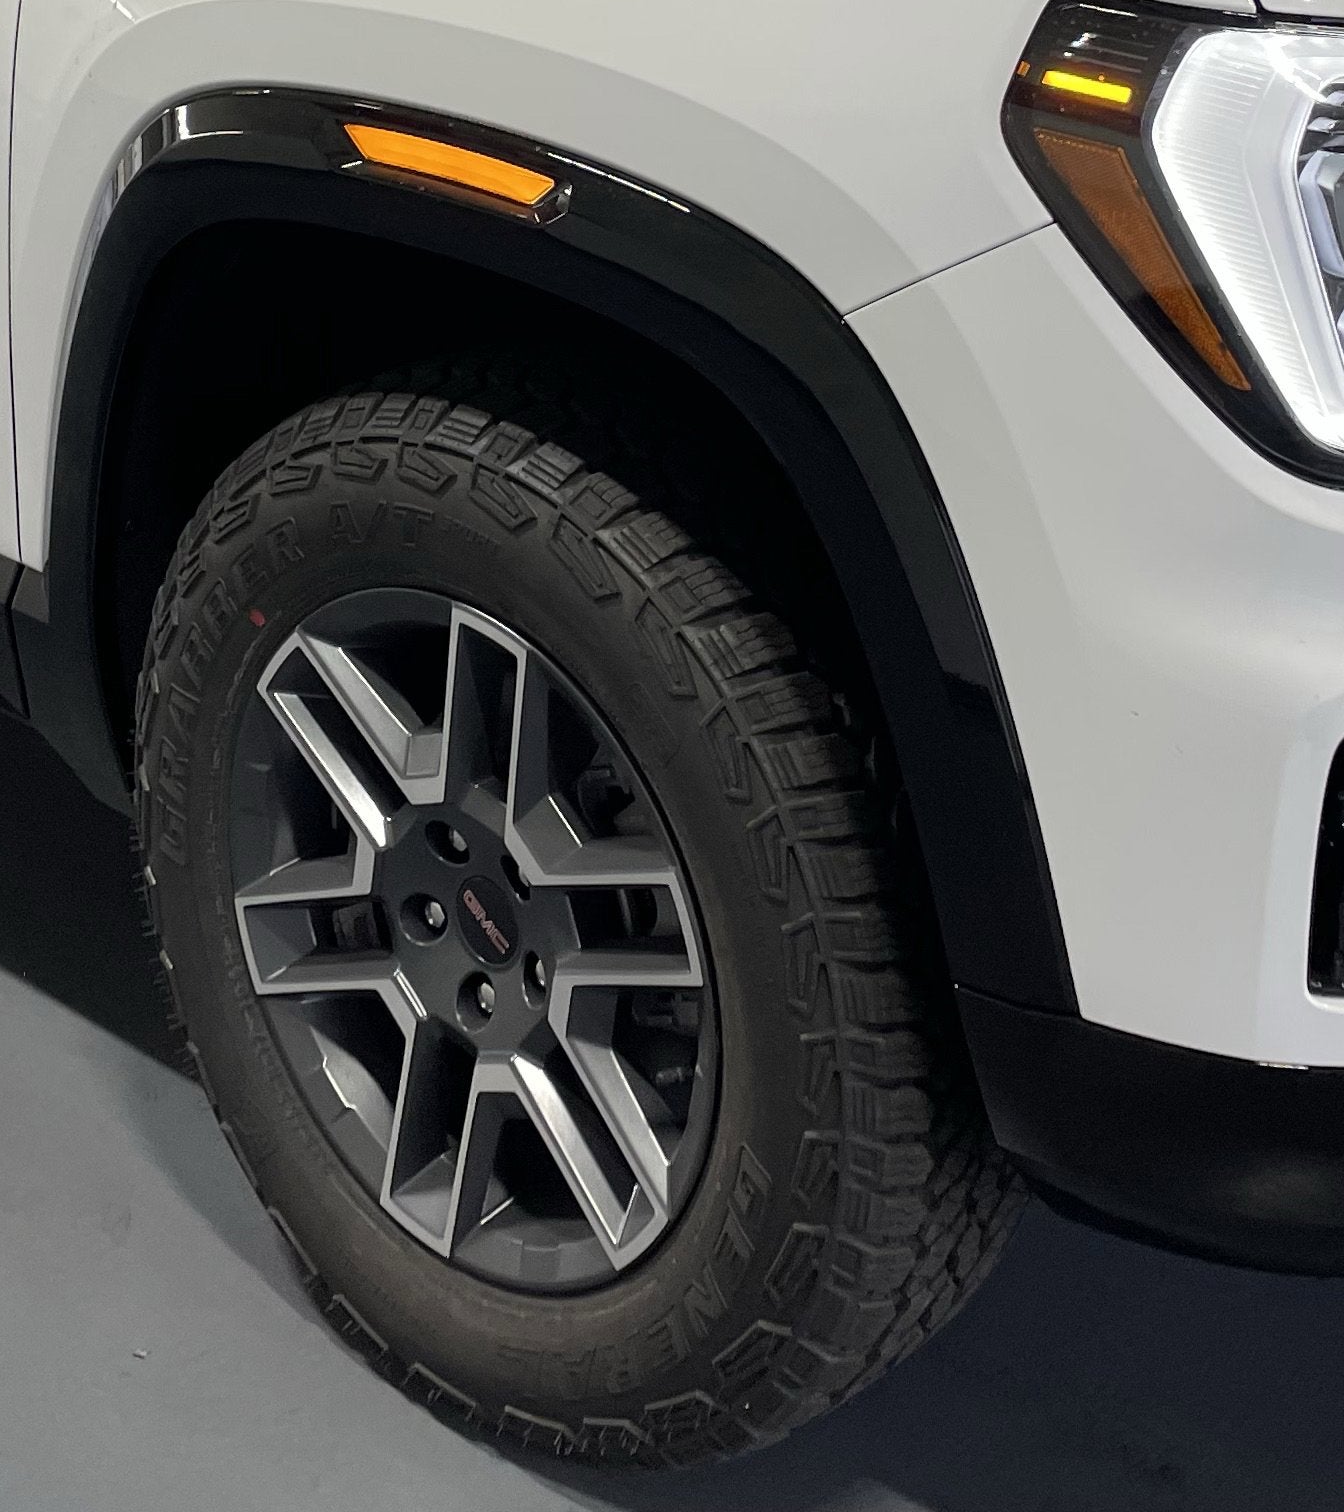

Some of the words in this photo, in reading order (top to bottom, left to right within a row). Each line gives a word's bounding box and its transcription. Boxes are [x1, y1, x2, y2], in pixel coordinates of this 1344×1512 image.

[158, 515, 307, 866] GRABBER
[328, 500, 435, 548] A/T
[463, 889, 510, 955] GMC
